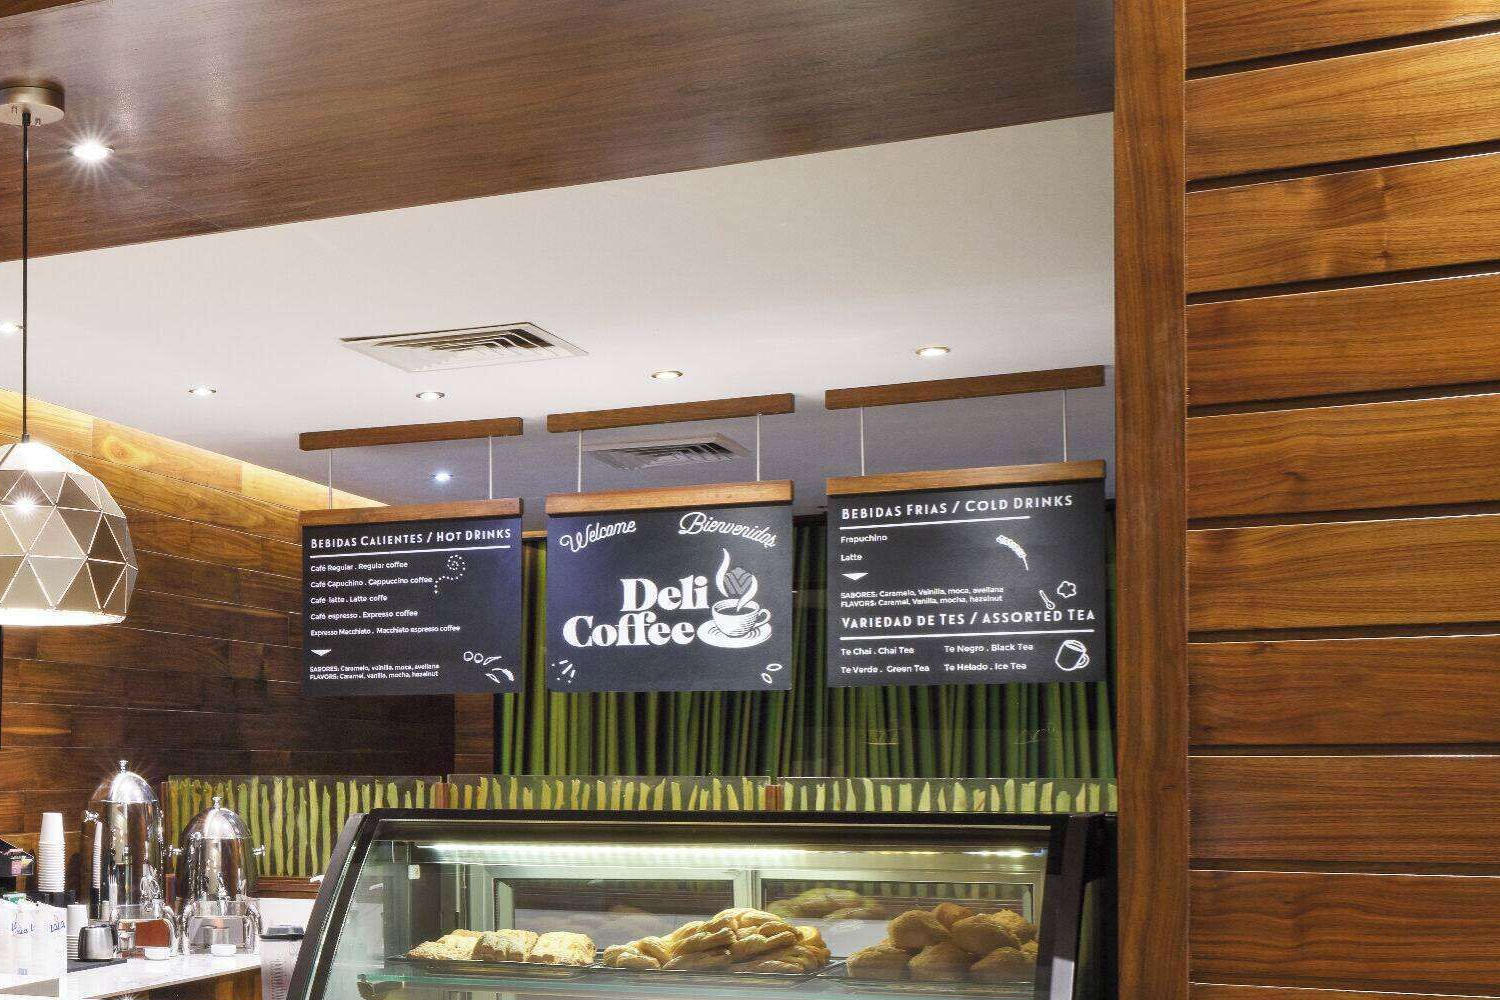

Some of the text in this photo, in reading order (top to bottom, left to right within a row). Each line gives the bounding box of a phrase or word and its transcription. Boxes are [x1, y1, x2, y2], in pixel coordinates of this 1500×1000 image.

[842, 505, 902, 520] BEBIDAS
[906, 503, 948, 516] FRIAS
[965, 499, 1009, 512] COLD
[1013, 495, 1073, 510] DRINKS
[678, 511, 778, 548] Bienvenidos
[311, 537, 357, 549] BEBIDAS
[360, 533, 423, 546] CALIENTES
[436, 531, 462, 542] HOT
[465, 528, 511, 541] DRINKS
[559, 520, 637, 553] Welcome
[840, 534, 888, 545] Frapuchino
[840, 553, 863, 562] Latte
[327, 563, 354, 573] Regular
[358, 562, 384, 571] Regular
[385, 560, 409, 569] coffee
[327, 579, 364, 589] Capuchino
[368, 577, 409, 587] Cappuccino
[410, 576, 433, 585] coffee
[349, 595, 368, 604] Latte
[619, 574, 710, 612] Deli
[840, 591, 878, 600] SABORES:
[973, 586, 1004, 594] avellana
[840, 600, 877, 609] FLAVORS:
[969, 595, 1003, 603] hazelnut
[327, 613, 358, 621] espresso
[362, 611, 394, 620] Expresso
[395, 609, 418, 618] coffee
[841, 615, 912, 629] VARIEDAD
[917, 615, 935, 627] DE
[939, 613, 965, 626] TES
[982, 610, 1063, 624] ASSORTED
[1067, 609, 1096, 621] TEA
[338, 627, 371, 636] Macchiato
[376, 626, 410, 635] Macchiato
[410, 626, 439, 635] espresso
[439, 624, 461, 633] coffee
[562, 610, 696, 648] Coffee
[841, 648, 852, 656] Te
[852, 647, 872, 656] Chai
[877, 646, 897, 655] Chai
[898, 646, 915, 655] Tea
[943, 645, 956, 654] Te
[956, 644, 985, 655] Negro
[990, 643, 1016, 652] Black
[1017, 643, 1034, 652] Tea
[841, 666, 852, 674] Te
[852, 665, 879, 674] Verde
[886, 664, 912, 674] Green
[913, 664, 930, 672] Tea
[943, 663, 956, 672] Te
[956, 662, 989, 672] Helado
[994, 662, 1009, 671] Ice
[1010, 662, 1027, 671] Tea
